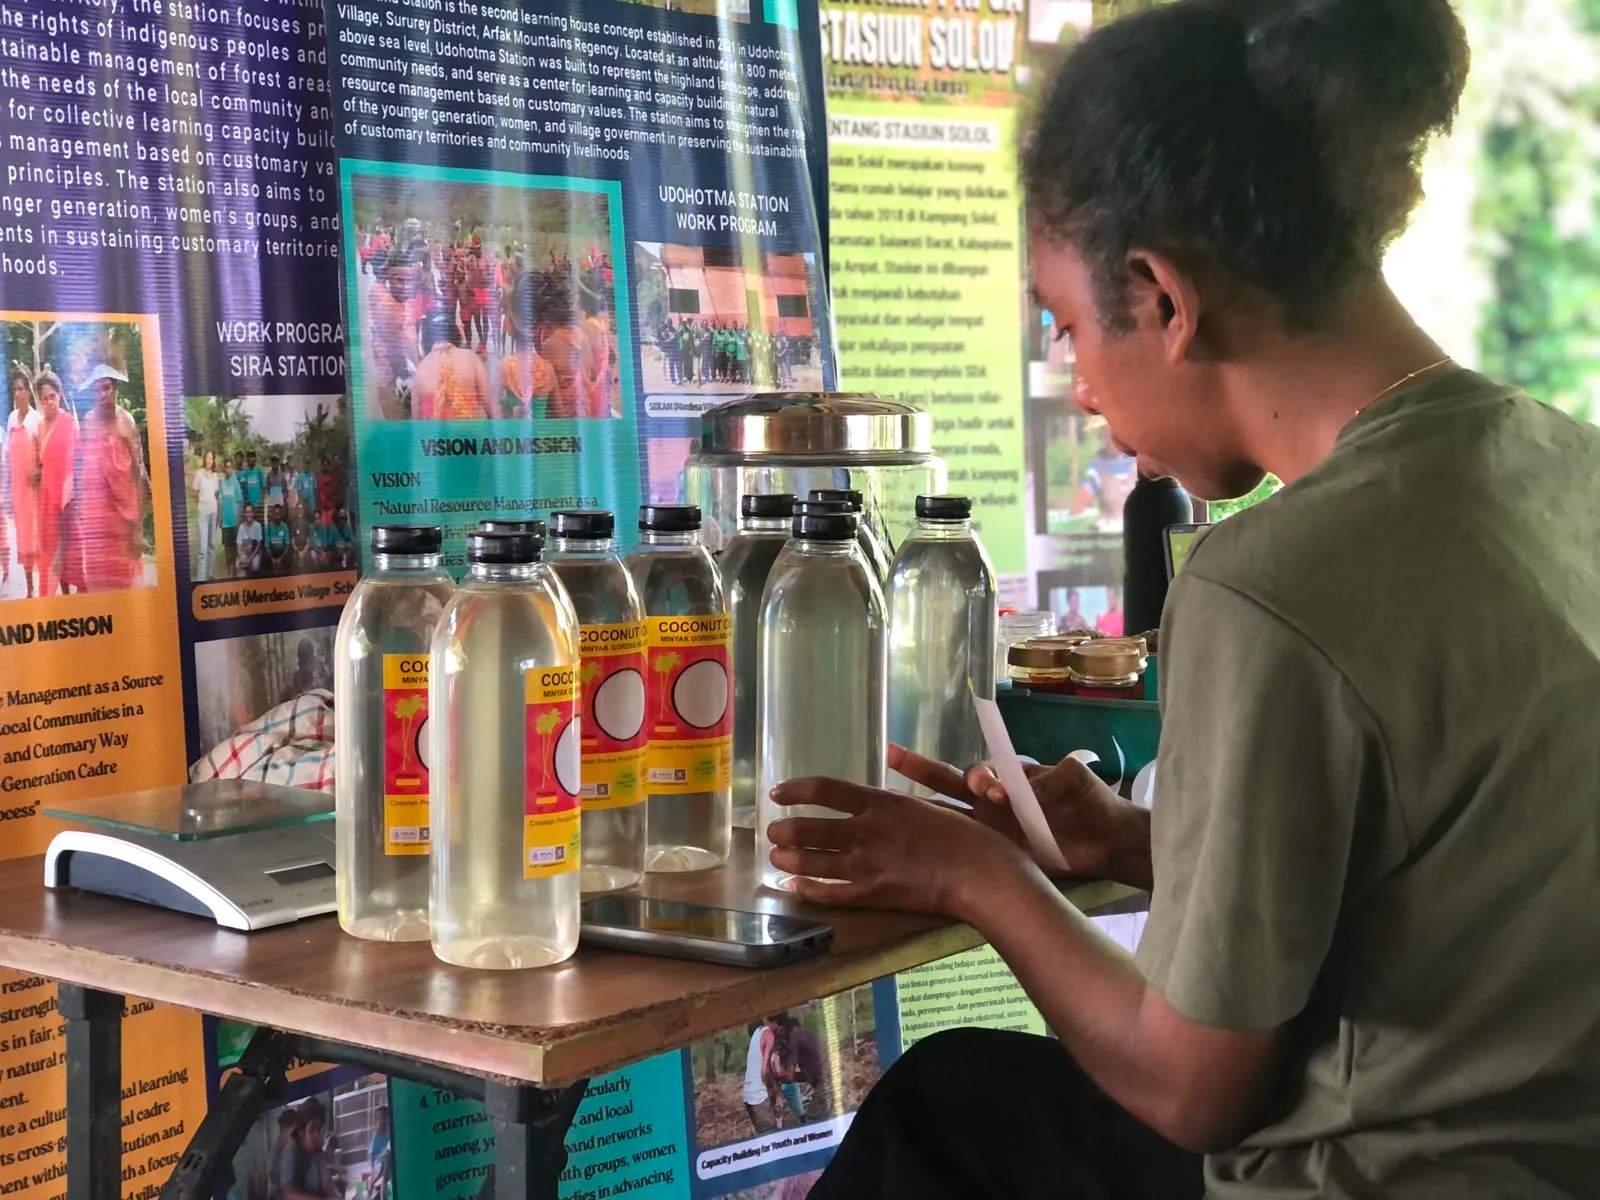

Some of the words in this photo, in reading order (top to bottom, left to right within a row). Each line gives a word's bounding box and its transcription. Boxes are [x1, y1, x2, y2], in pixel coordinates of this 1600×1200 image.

[237, 7, 300, 34] focuses
[338, 4, 382, 27] Village,
[386, 12, 430, 34] Sururey
[434, 18, 479, 40] District,
[483, 25, 511, 42] Arfak
[514, 33, 571, 50] Mountains
[575, 40, 622, 59] Regency.
[625, 47, 664, 63] Located
[459, 2, 477, 15] the
[481, 6, 518, 22] second
[521, 9, 567, 31] learning
[570, 16, 600, 33] house
[603, 22, 644, 40] concept
[647, 30, 702, 49] established
[32, 12, 89, 36] rights
[98, 21, 113, 38] of
[121, 22, 218, 52] indigenous
[228, 38, 289, 62] peoples
[89, 51, 200, 77] management
[209, 64, 227, 80] of
[234, 66, 280, 88] forest
[339, 29, 375, 46] above
[379, 36, 400, 49] sea
[436, 41, 495, 62] Udohotma
[499, 50, 535, 67] Station
[539, 57, 561, 69] was
[565, 59, 586, 74] built
[588, 63, 599, 75] to
[603, 66, 651, 85] represent
[654, 69, 669, 83] the
[671, 72, 714, 92] highland
[341, 53, 407, 75] community
[411, 62, 447, 80] needs,
[451, 66, 473, 80] and
[477, 70, 506, 85] serve
[509, 74, 520, 86] as
[533, 78, 569, 91] center
[572, 79, 585, 94] for
[588, 82, 631, 102] learning
[634, 88, 651, 101] and
[654, 91, 694, 111] capacity
[40, 75, 96, 95] needs
[104, 82, 120, 98] of
[127, 83, 156, 103] the
[165, 85, 202, 107] local
[212, 93, 302, 122] community
[342, 76, 395, 93] resource
[399, 83, 474, 103] management
[478, 89, 509, 106] based
[513, 95, 525, 108] on
[528, 99, 584, 118] customary
[588, 105, 625, 119] values.
[629, 107, 647, 121] The
[650, 110, 682, 126] station
[686, 115, 710, 129] aims
[713, 119, 723, 130] to
[10, 100, 34, 120] for
[44, 105, 134, 130] collective
[144, 112, 213, 141] learning
[222, 123, 289, 149] capacity
[344, 97, 357, 111] of
[359, 99, 378, 114] the
[382, 103, 428, 119] younger
[544, 120, 565, 133] and
[568, 123, 600, 139] village
[604, 127, 665, 144] government
[678, 135, 730, 152] preserving
[345, 120, 358, 134] of
[361, 123, 422, 145] customary
[426, 129, 484, 147] territories
[487, 133, 506, 149] and
[509, 139, 570, 158] community
[10, 134, 129, 159] management
[137, 142, 189, 163] based
[196, 152, 214, 166] on
[224, 152, 308, 178] customary
[8, 163, 109, 189] principles.
[117, 170, 148, 190] The
[159, 174, 215, 195] station
[224, 179, 259, 197] also
[266, 180, 300, 200] aims
[309, 185, 325, 202] to
[659, 186, 736, 206] UDOHOTMA
[739, 194, 788, 212] STATION
[51, 198, 157, 223] generation,
[246, 209, 302, 230] groups,
[677, 213, 716, 230] WORK
[720, 215, 777, 236] PROGRAM
[42, 227, 57, 244] in
[67, 228, 162, 253] sustaining
[172, 233, 258, 258] customary
[217, 321, 272, 343] WORK
[277, 322, 344, 343] PROGRA
[231, 356, 273, 376] SIRA
[421, 438, 477, 456] VISION
[481, 438, 512, 455] AND
[516, 437, 582, 456] MISSION
[372, 473, 420, 488] VISION
[431, 500, 492, 512] Resource
[495, 497, 573, 512] Management
[201, 591, 239, 609] SEKAM
[298, 584, 329, 602] Village
[38, 615, 113, 641] MISSION
[659, 620, 722, 632] COCONUT
[7, 683, 91, 707] Management
[95, 683, 109, 694] as
[112, 682, 119, 692] a
[122, 675, 163, 689] Source
[544, 689, 567, 697] MINYAK
[34, 706, 120, 731] Communities
[122, 704, 135, 717] in
[137, 705, 144, 714] a
[4, 746, 31, 764] and
[34, 738, 96, 758] Cutomary
[99, 733, 128, 748] Way
[78, 761, 117, 778] Cadre
[955, 959, 976, 969] belajar
[937, 1018, 961, 1026] internal
[12, 1035, 26, 1049] in
[7, 1053, 57, 1079] natural
[139, 1068, 188, 1094] learning
[137, 1100, 170, 1121] cadre
[580, 1109, 603, 1125] and
[606, 1102, 632, 1121] local
[162, 1120, 184, 1138] and
[434, 1138, 480, 1160] among
[598, 1122, 652, 1146] networks
[632, 1144, 676, 1165] women
[702, 1155, 731, 1169] Capacity
[733, 1147, 760, 1161] Building
[808, 1129, 833, 1141] Women
[612, 1168, 673, 1194] advancing
